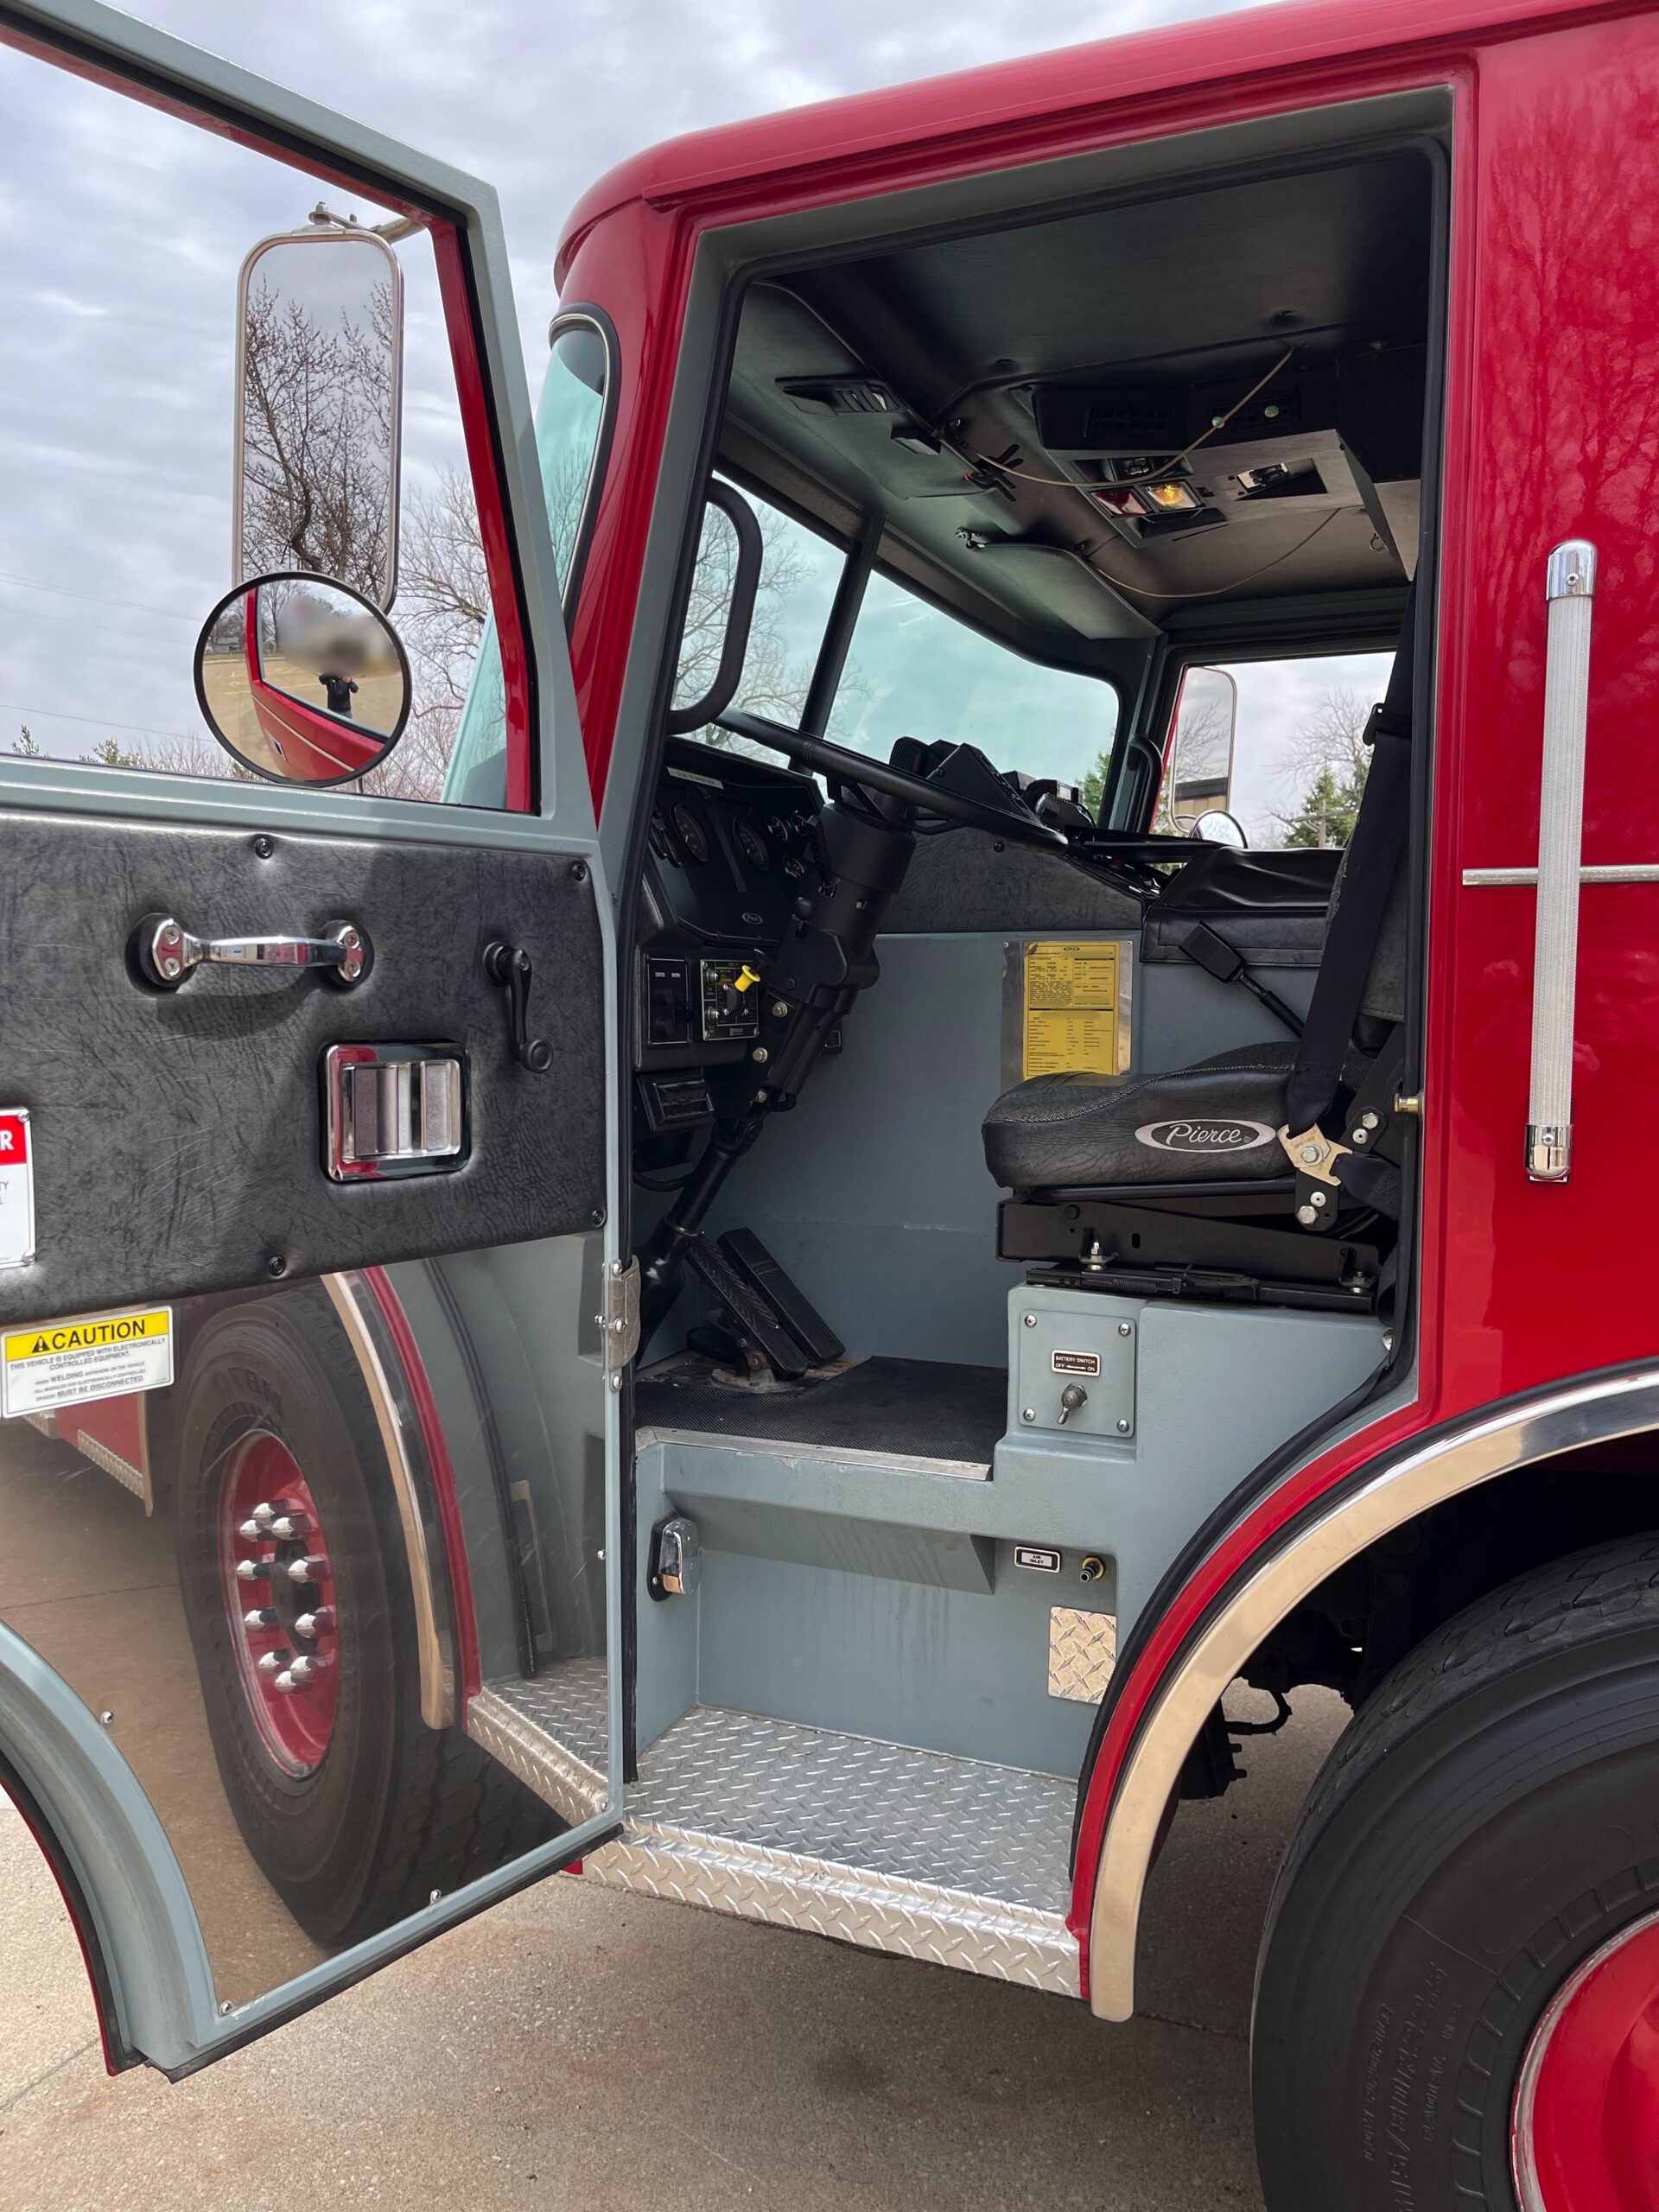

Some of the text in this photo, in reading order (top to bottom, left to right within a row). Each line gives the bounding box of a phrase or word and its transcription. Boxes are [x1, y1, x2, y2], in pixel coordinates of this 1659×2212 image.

[1166, 1122, 1243, 1147] Pierce
[52, 1319, 145, 1350] CAUTION
[27, 1357, 54, 1367] VEHICLE
[64, 1350, 95, 1362] EQUIPPED
[97, 1346, 111, 1355] WITH
[113, 1338, 166, 1351] ELECTRONICALLY
[49, 1351, 131, 1370] CONTROLLED EQUIPMENT.
[50, 1371, 84, 1382] WELDING
[57, 1388, 78, 1397] MUST
[79, 1385, 88, 1394] BE
